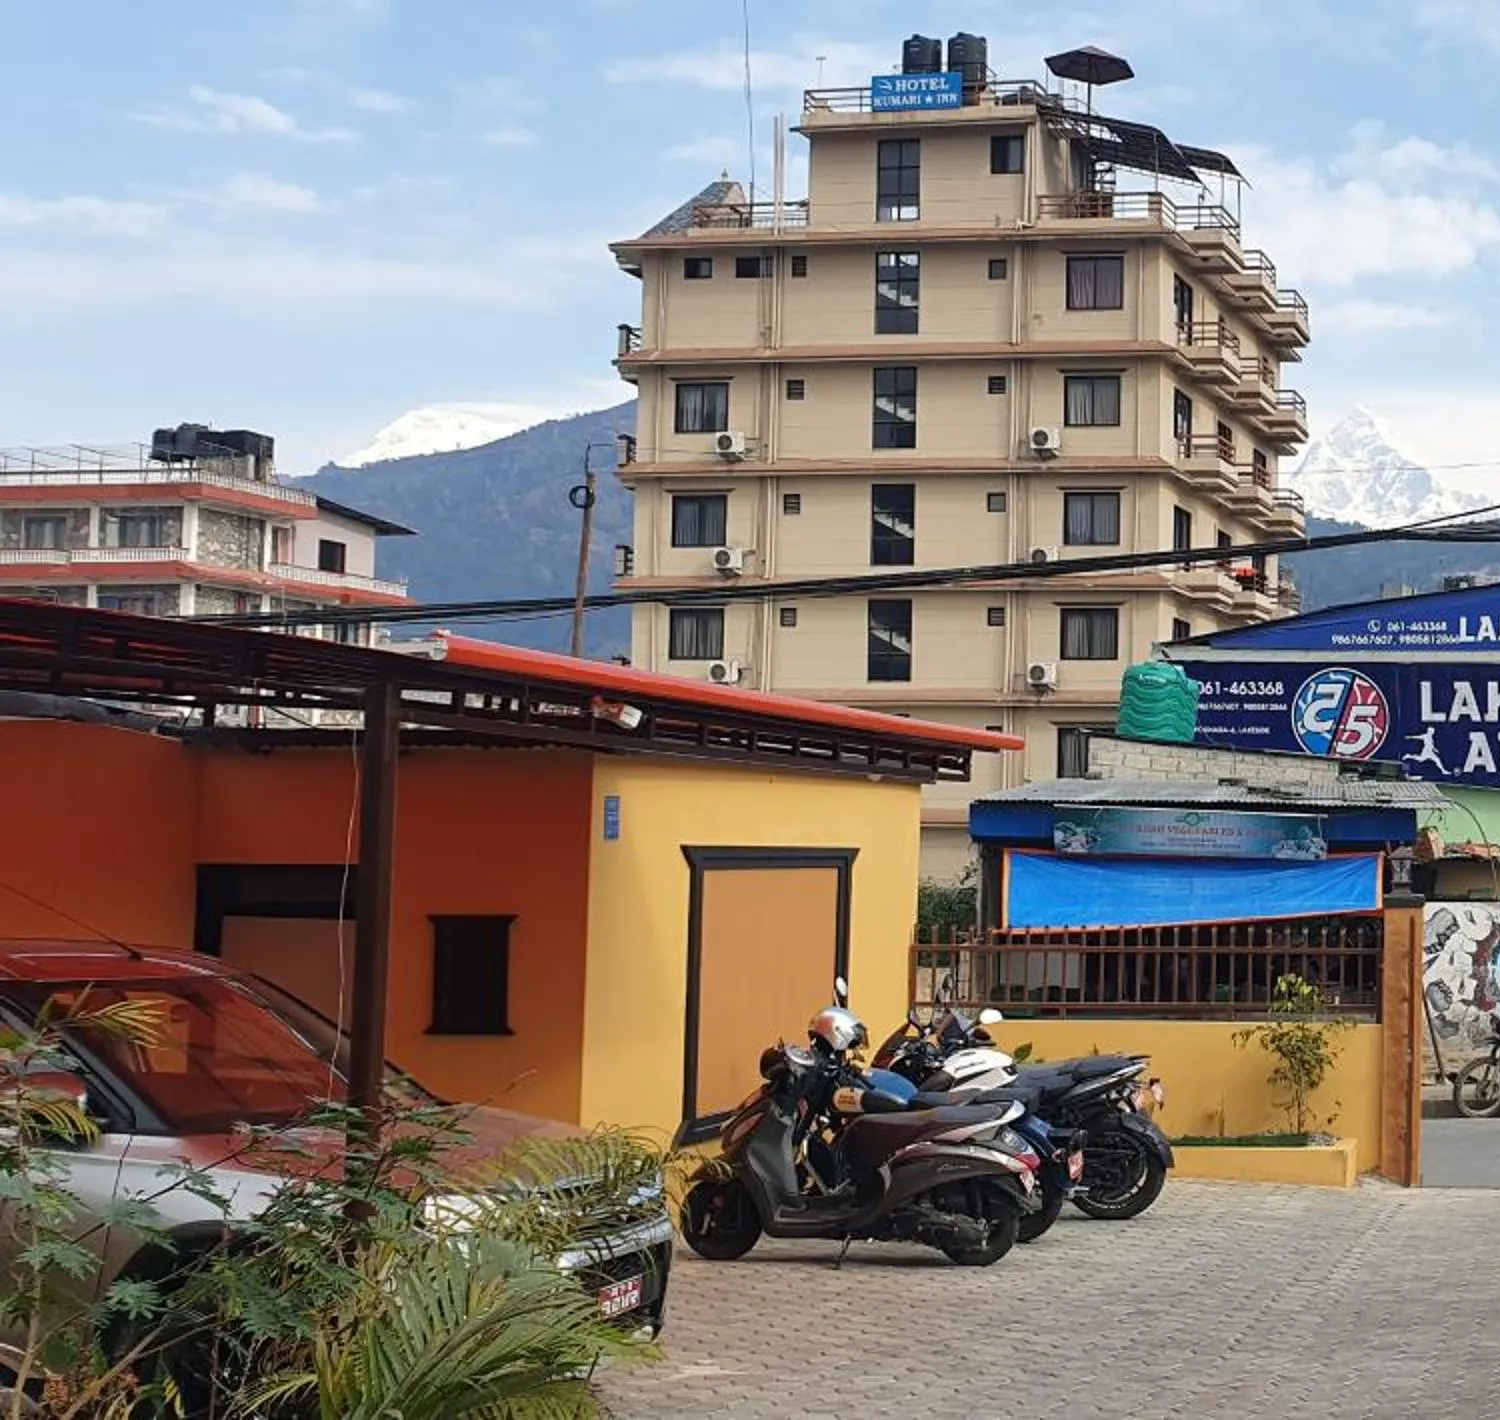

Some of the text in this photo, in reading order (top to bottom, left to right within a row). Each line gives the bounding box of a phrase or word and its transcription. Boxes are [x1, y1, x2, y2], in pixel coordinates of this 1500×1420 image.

[895, 78, 949, 92] HOTEL
[873, 93, 958, 107] KUMARI INN
[1387, 621, 1447, 632] 061-463368
[1198, 681, 1285, 696] 061-463368
